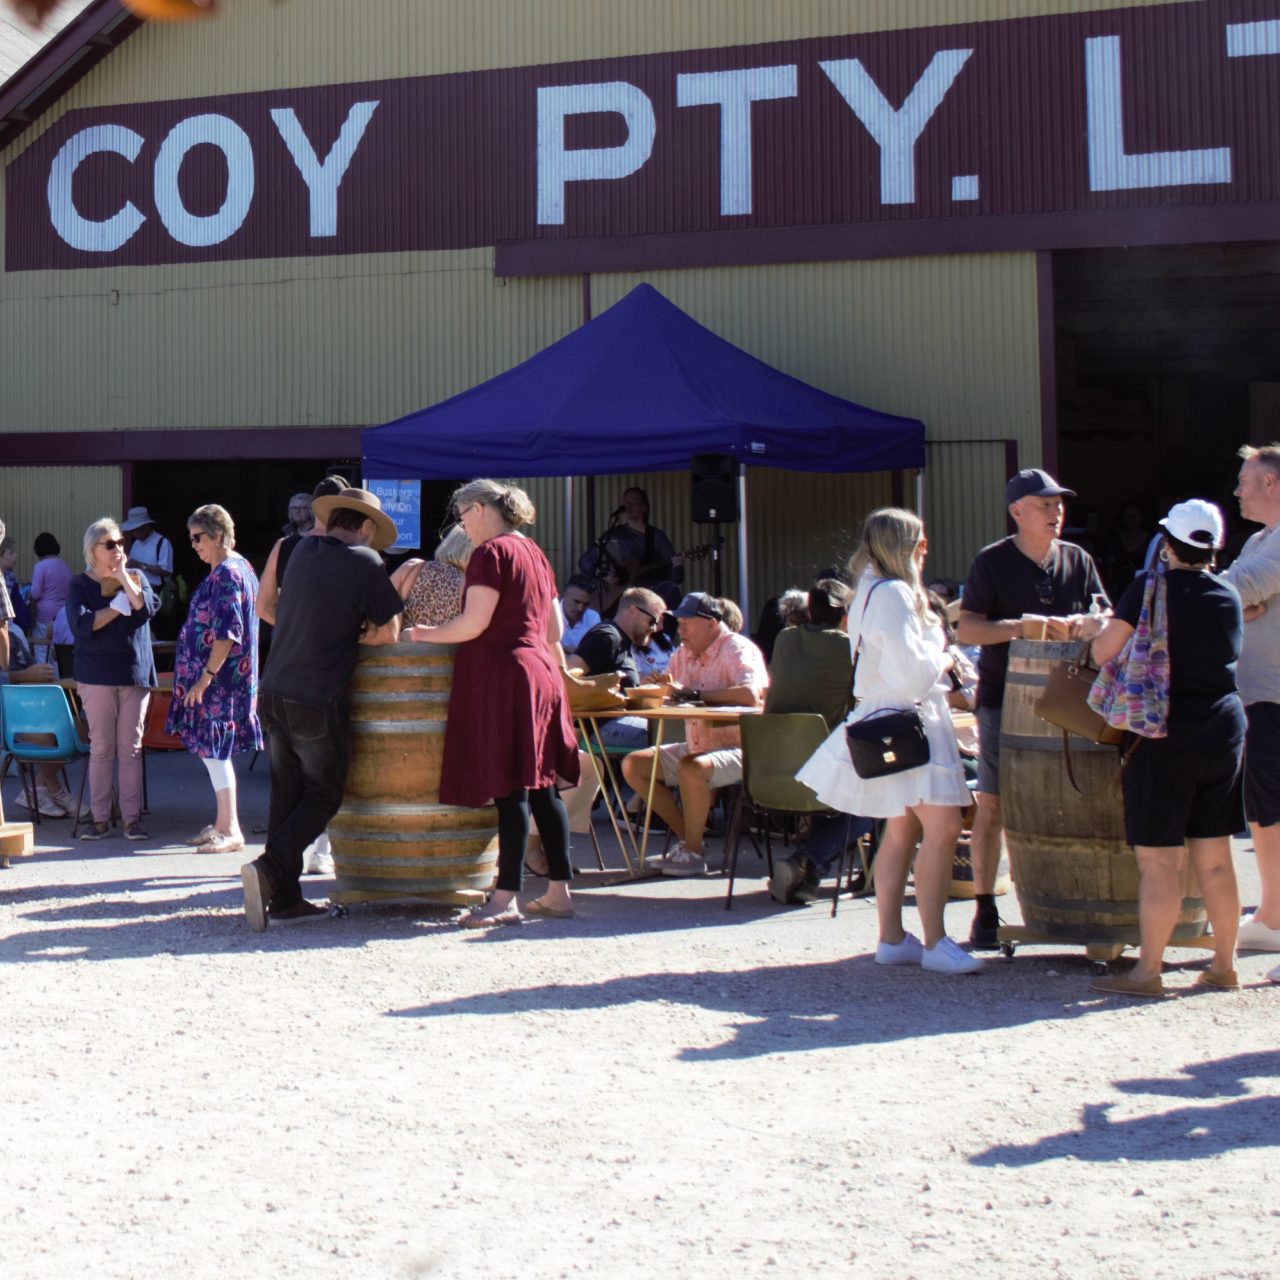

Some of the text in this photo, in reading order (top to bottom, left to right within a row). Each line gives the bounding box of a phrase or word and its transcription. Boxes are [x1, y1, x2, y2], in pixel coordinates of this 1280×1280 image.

[47, 20, 1280, 252] COY PTY. L
[376, 487, 412, 497] Buskers
[382, 502, 412, 512] ely On
